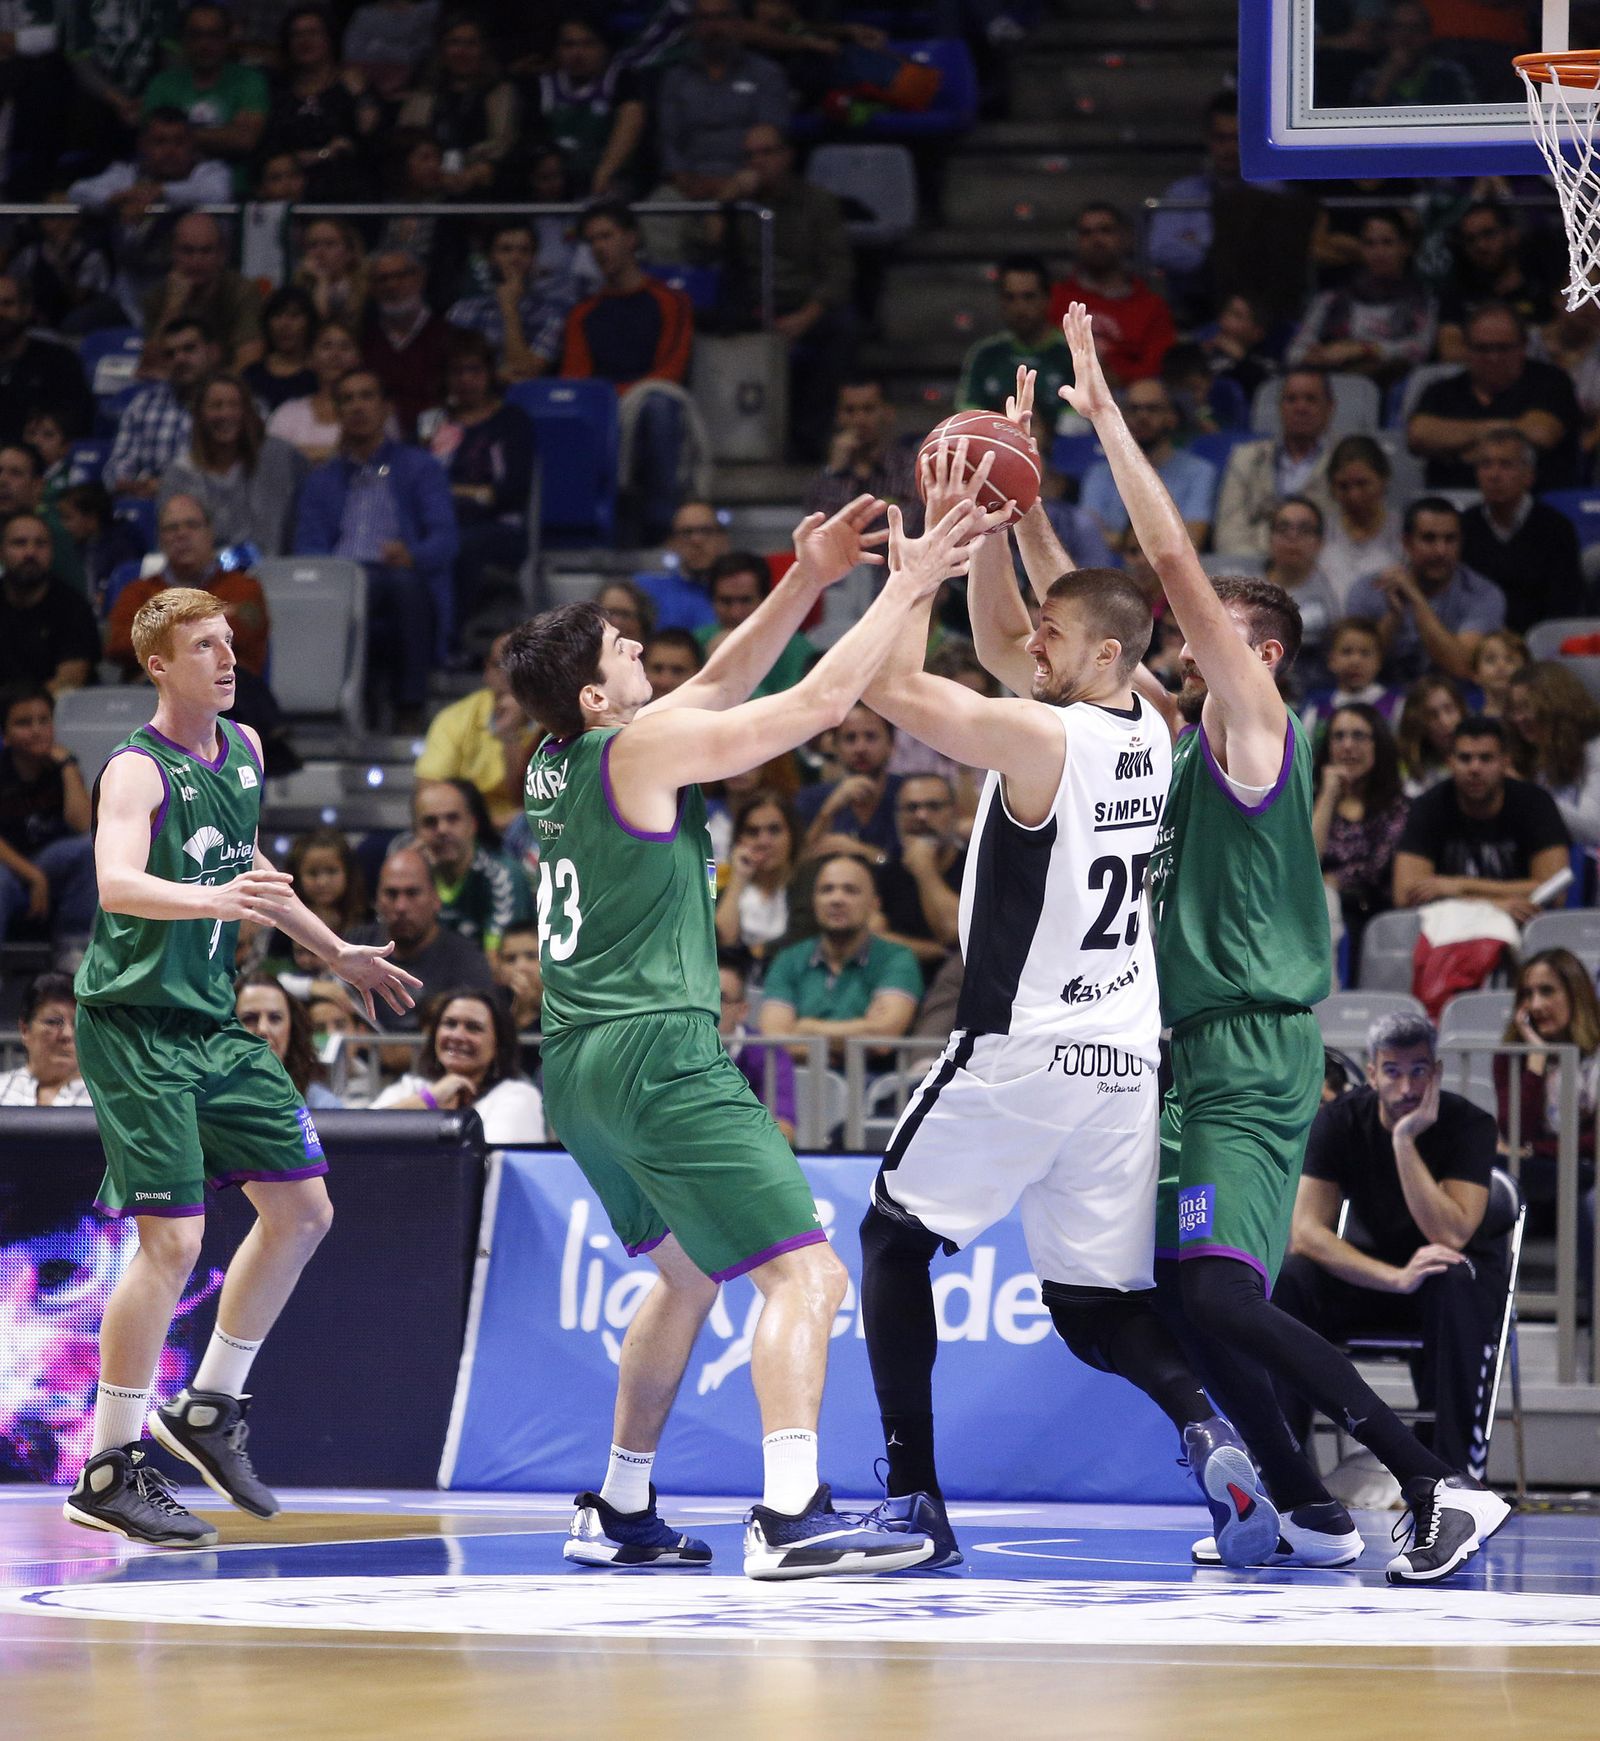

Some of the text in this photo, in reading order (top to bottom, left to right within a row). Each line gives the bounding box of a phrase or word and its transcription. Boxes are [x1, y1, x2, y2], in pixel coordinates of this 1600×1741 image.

[1115, 747, 1154, 781] BUVA
[537, 858, 582, 962] 43
[135, 1191, 171, 1202] SPALDING
